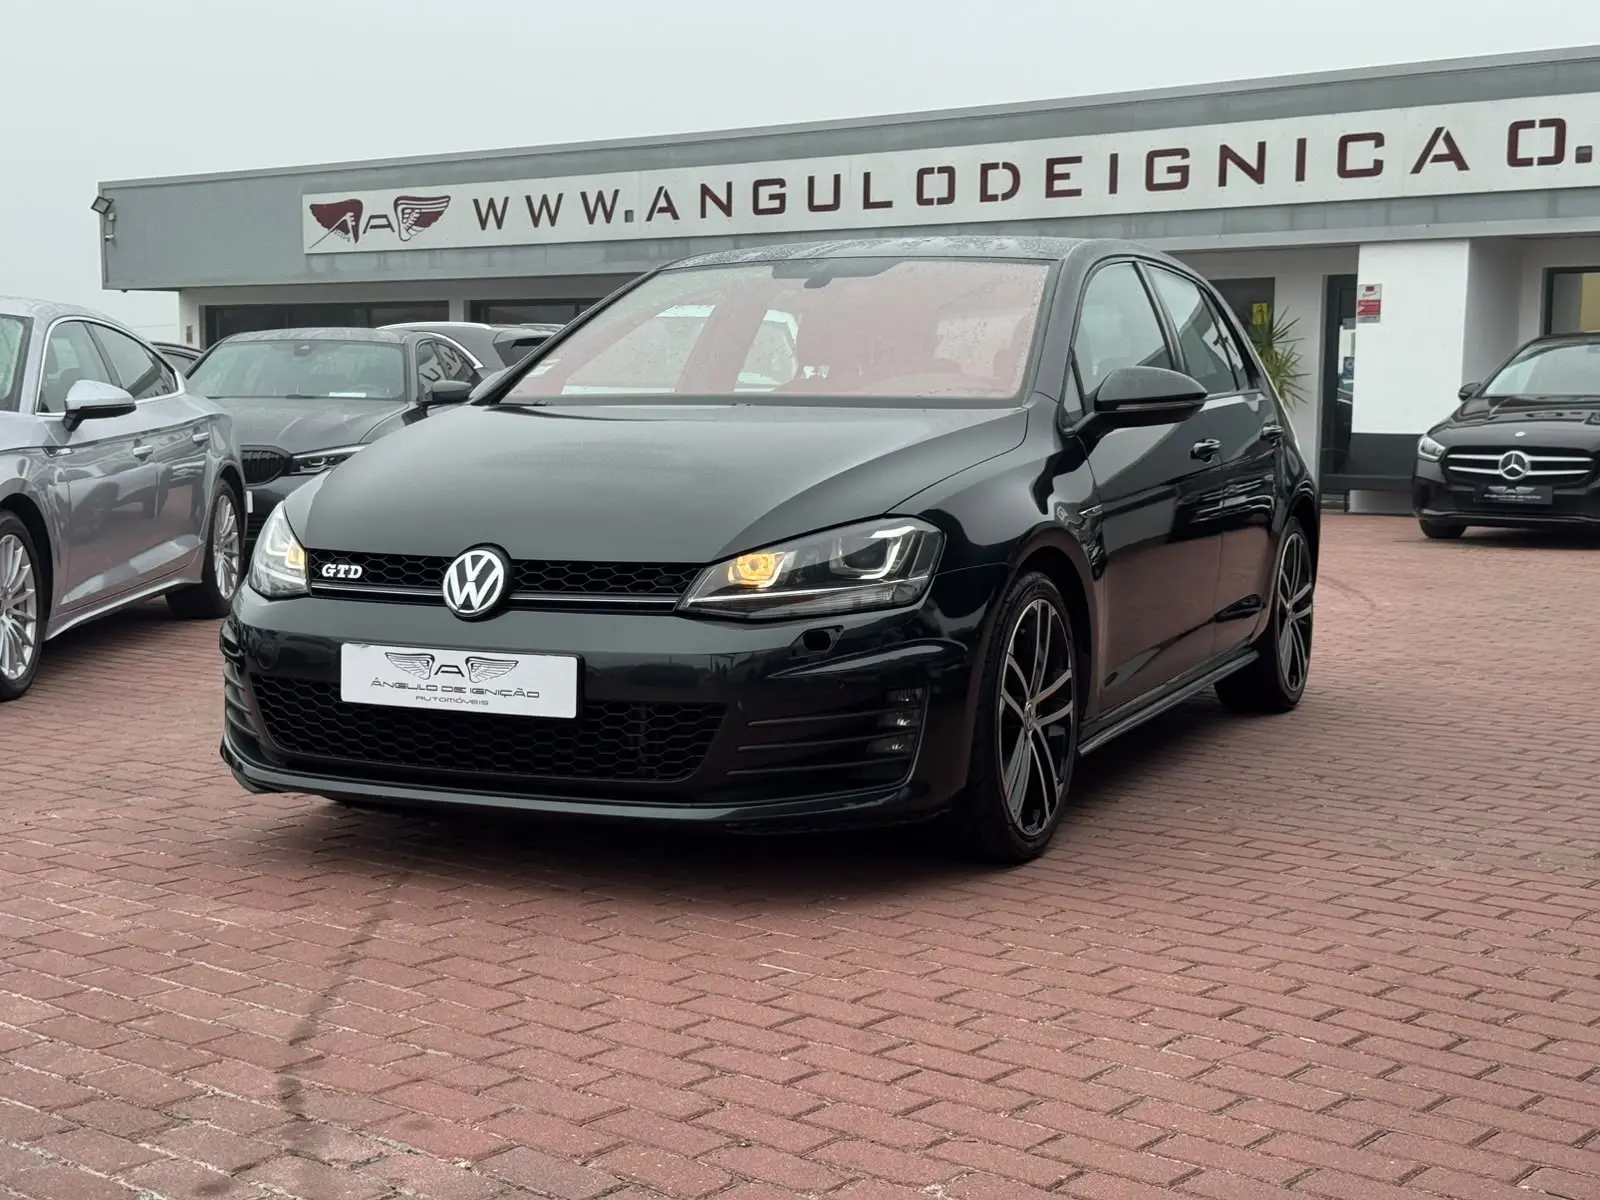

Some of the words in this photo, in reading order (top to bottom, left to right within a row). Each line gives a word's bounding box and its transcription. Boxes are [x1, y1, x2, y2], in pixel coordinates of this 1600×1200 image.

[321, 564, 362, 579] GTD
[370, 677, 438, 691] ÂNGULO
[441, 685, 467, 694] DE
[469, 687, 540, 699] IGNIÇÃO
